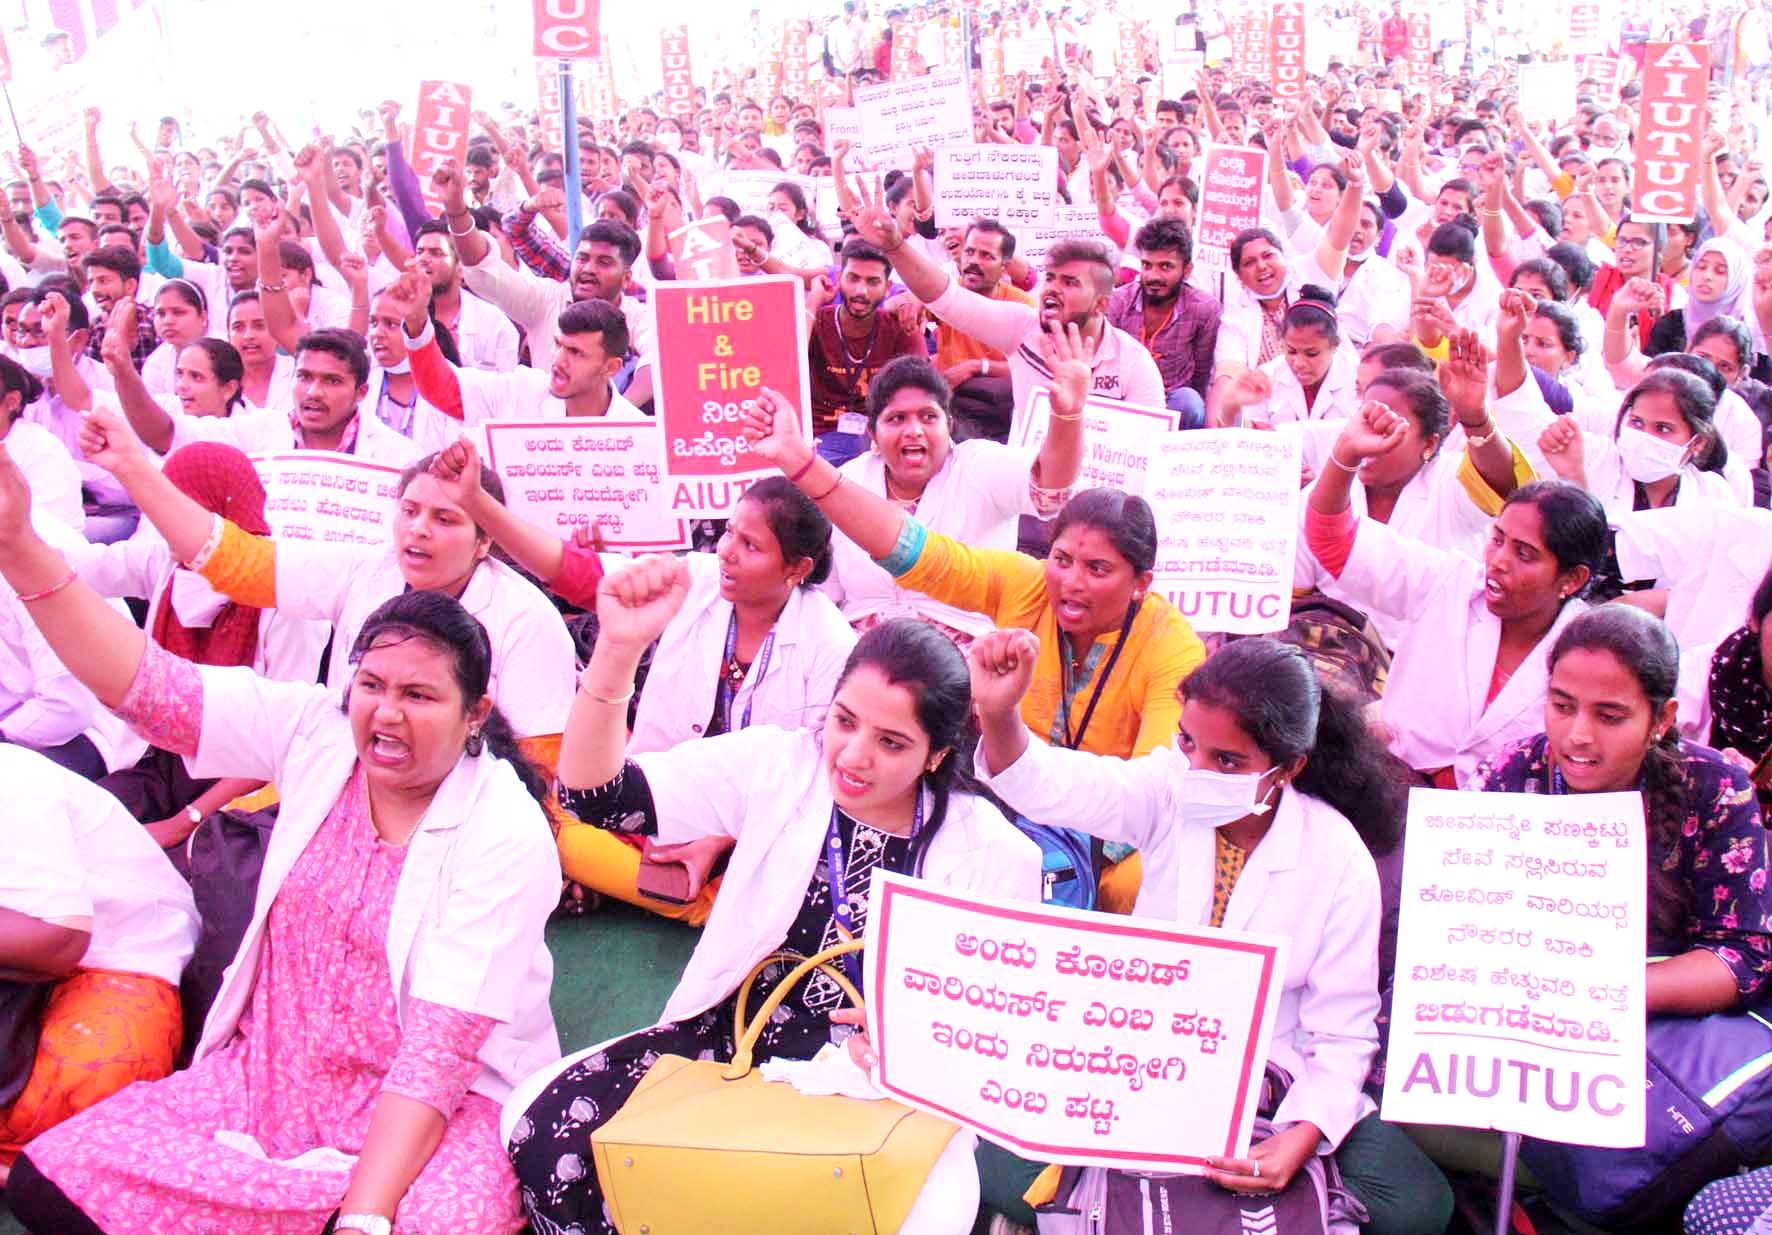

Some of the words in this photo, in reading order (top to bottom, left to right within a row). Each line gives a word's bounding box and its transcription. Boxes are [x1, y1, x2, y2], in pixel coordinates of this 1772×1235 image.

[1274, 2, 1303, 96] AIUTUC
[1410, 13, 1430, 86] AIUTUC
[662, 26, 692, 114] AIUTUC
[1641, 43, 1703, 214] AIUTUC
[687, 296, 753, 325] Hire
[714, 334, 734, 356] &
[698, 363, 761, 391] Fire
[525, 437, 565, 452] ಅಂದು
[572, 435, 634, 452] ಕೋವಿಡ್
[1092, 441, 1149, 472] Warriors
[592, 463, 625, 477] ಎಂಬ
[525, 488, 565, 504] ಇಂದು
[556, 512, 590, 526] ಎಂಬ
[1543, 819, 1629, 848] ಪಣಕ್ಕಿಟ್ಟು
[1442, 848, 1495, 867] ಸೇವೆ
[1505, 851, 1608, 880] ಸಲ್ಲಿಸಿರುವ
[1419, 884, 1514, 905] ಕೋವಿಡ್
[1447, 923, 1533, 947] ನೌಕರರ
[1544, 937, 1596, 958] ಬಾಕಿ
[955, 930, 1037, 970] ಅಂದು
[1056, 945, 1192, 987] ಕೋವಿಡ್
[1411, 964, 1478, 984] ವಿಶೇಷ
[1490, 967, 1577, 1001] ಹೆಚ್ಚುವರಿ
[904, 967, 1067, 1023] ವಾರಿಯರ್ಸ್
[1083, 1001, 1154, 1032] ಎಂಬ
[1172, 1009, 1228, 1054] ಪಟ್ಟ.
[1414, 1000, 1620, 1043] ಬಿಡುಗಡೆಮಾಡಿ.
[931, 1021, 1009, 1061] ಇಂದು
[1026, 1042, 1187, 1092] ನಿರುದ್ಯೋಗಿ
[1401, 1052, 1627, 1117] AIUTUC
[980, 1080, 1048, 1115] ಎಂಬ
[1065, 1092, 1120, 1136] ಪಟ್ಟ.
